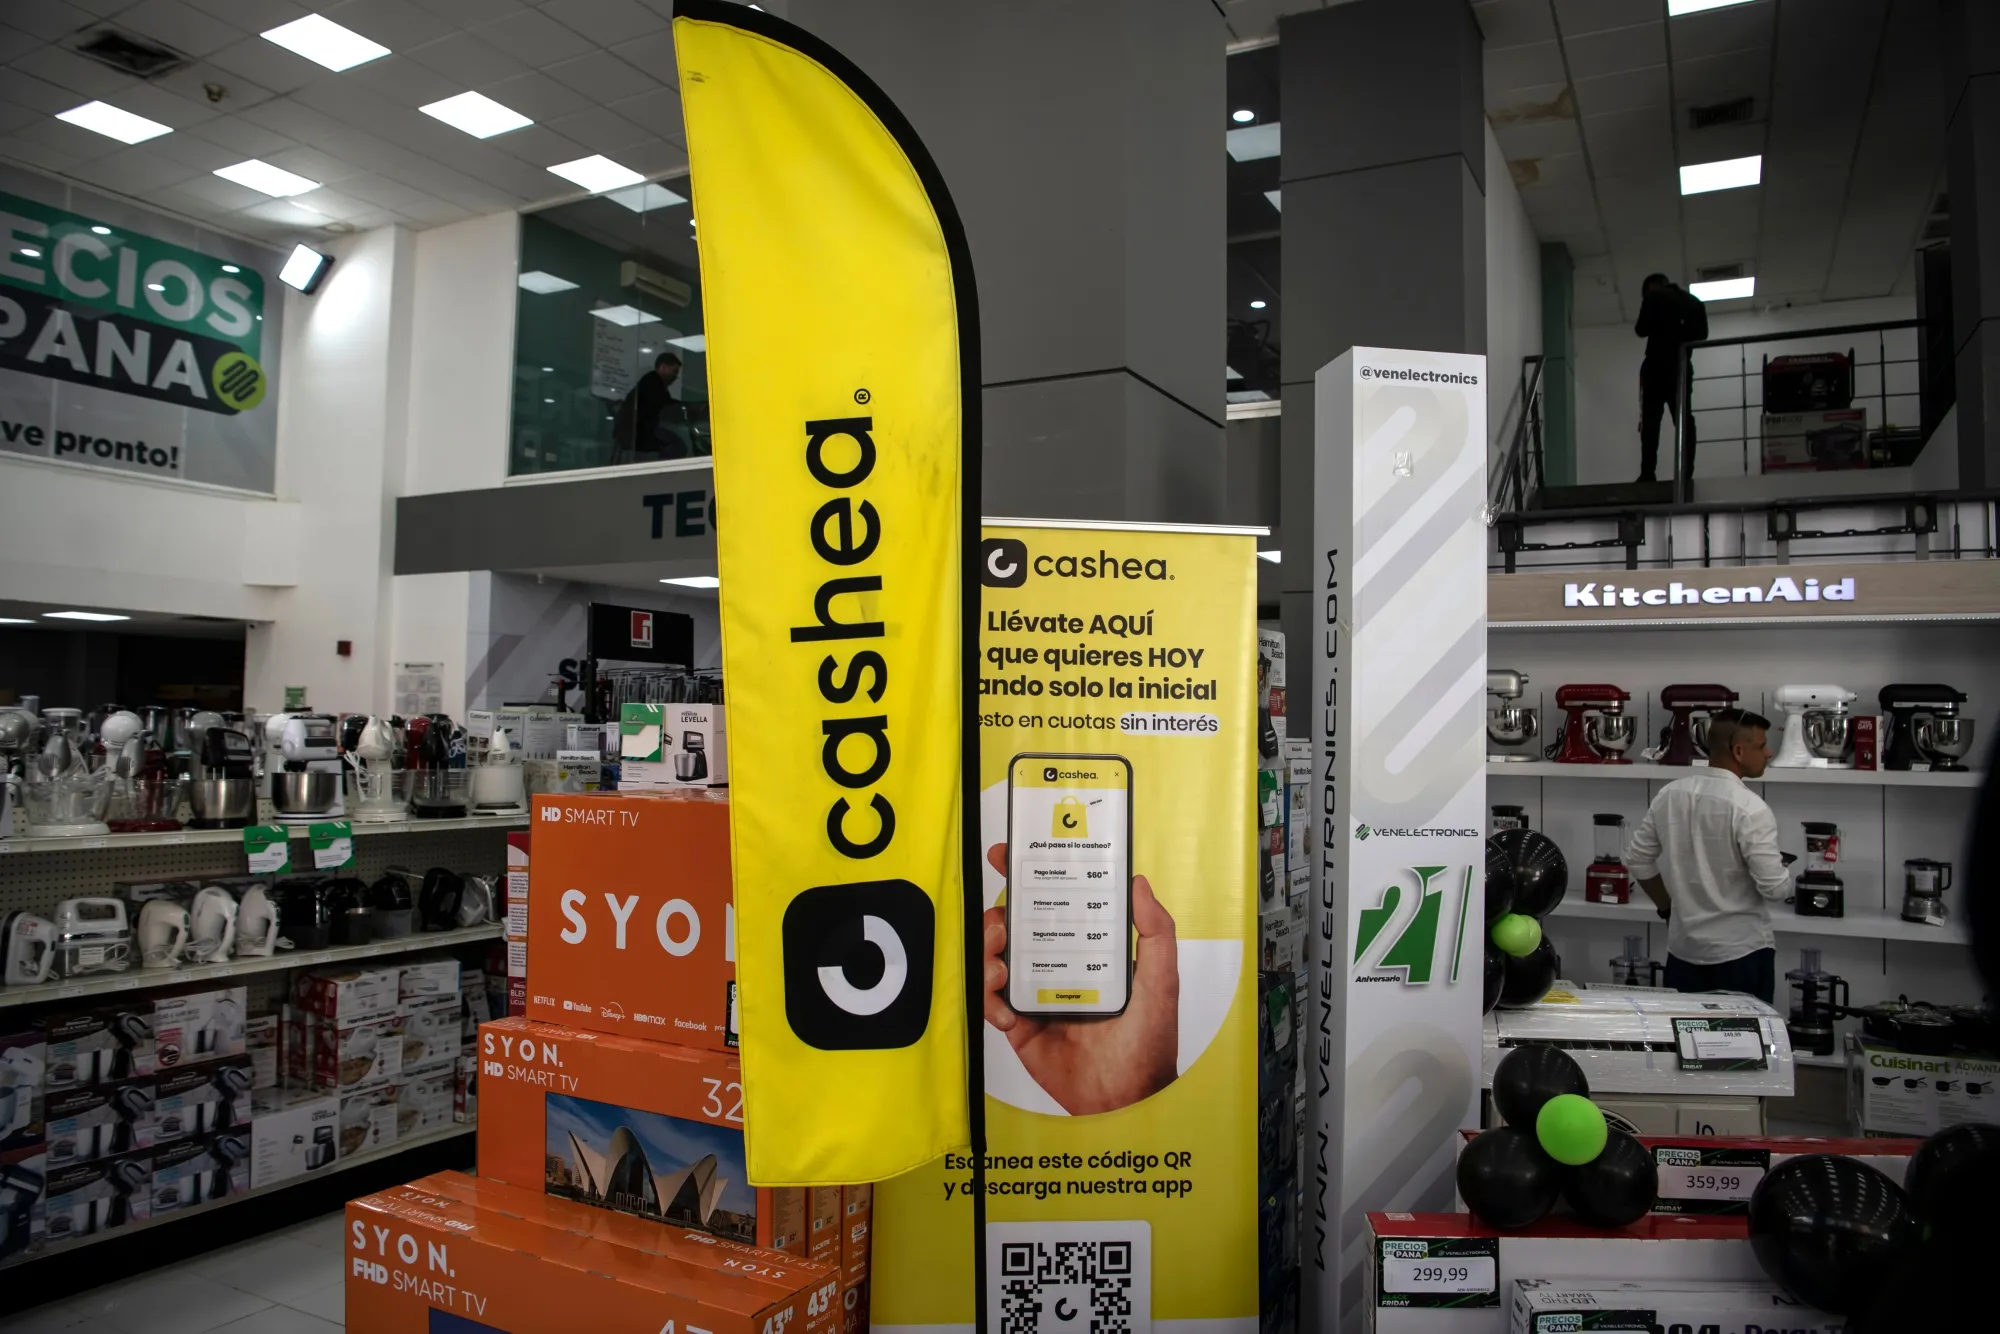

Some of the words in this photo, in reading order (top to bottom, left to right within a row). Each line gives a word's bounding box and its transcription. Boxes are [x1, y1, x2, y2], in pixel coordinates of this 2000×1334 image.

[0, 210, 253, 337] ECIOS
[1360, 366, 1478, 385] @venelectronics
[54, 430, 179, 468] pronto!
[643, 490, 716, 538] TE
[1564, 577, 1855, 607] KitchenAid
[987, 609, 1083, 634] Llévate
[1089, 609, 1155, 638] AQUÍ
[987, 646, 1038, 670] que
[1043, 643, 1143, 672] quieres
[1149, 648, 1204, 668] HOY
[1049, 677, 1103, 698] solo
[1109, 677, 1132, 698] la
[1138, 676, 1217, 700] inicial
[681, 716, 709, 724] LEVELLA
[1019, 715, 1043, 728] en
[1047, 714, 1115, 730] cuotas
[1120, 713, 1148, 731] sin
[1152, 713, 1218, 732] interés
[541, 807, 561, 821] HD
[565, 808, 613, 826] SMART
[619, 811, 639, 827] TV
[1373, 828, 1479, 837] VENELECTRONICS
[1087, 902, 1102, 910] $20
[533, 995, 556, 1007] NETFLIX
[572, 1002, 592, 1013] YouTube
[674, 1018, 707, 1032] facebook
[484, 1033, 564, 1067] SYON.
[484, 1060, 504, 1077] HD
[507, 1065, 555, 1087] SMART
[559, 1074, 579, 1091] TV
[1870, 1054, 1951, 1073] Cuisinart
[702, 1077, 744, 1123] 32
[1038, 1153, 1083, 1169] este
[1088, 1151, 1159, 1174] código
[1164, 1151, 1192, 1171] QR
[1658, 1150, 1700, 1159] PRECIOS
[1669, 1158, 1694, 1166] PANA
[943, 1181, 956, 1201] y
[961, 1178, 1061, 1200] dscarga
[1067, 1177, 1147, 1195] nuestra
[1152, 1179, 1193, 1199] app
[1686, 1175, 1740, 1191] 359,99
[352, 1219, 456, 1278] SYON.
[684, 1233, 717, 1245] FHD
[717, 1240, 773, 1259] SMART
[774, 1254, 799, 1264] TV
[353, 1257, 388, 1285] FHD
[393, 1270, 456, 1306] SMART
[461, 1290, 487, 1316] TV
[1413, 1267, 1468, 1283] 299,99
